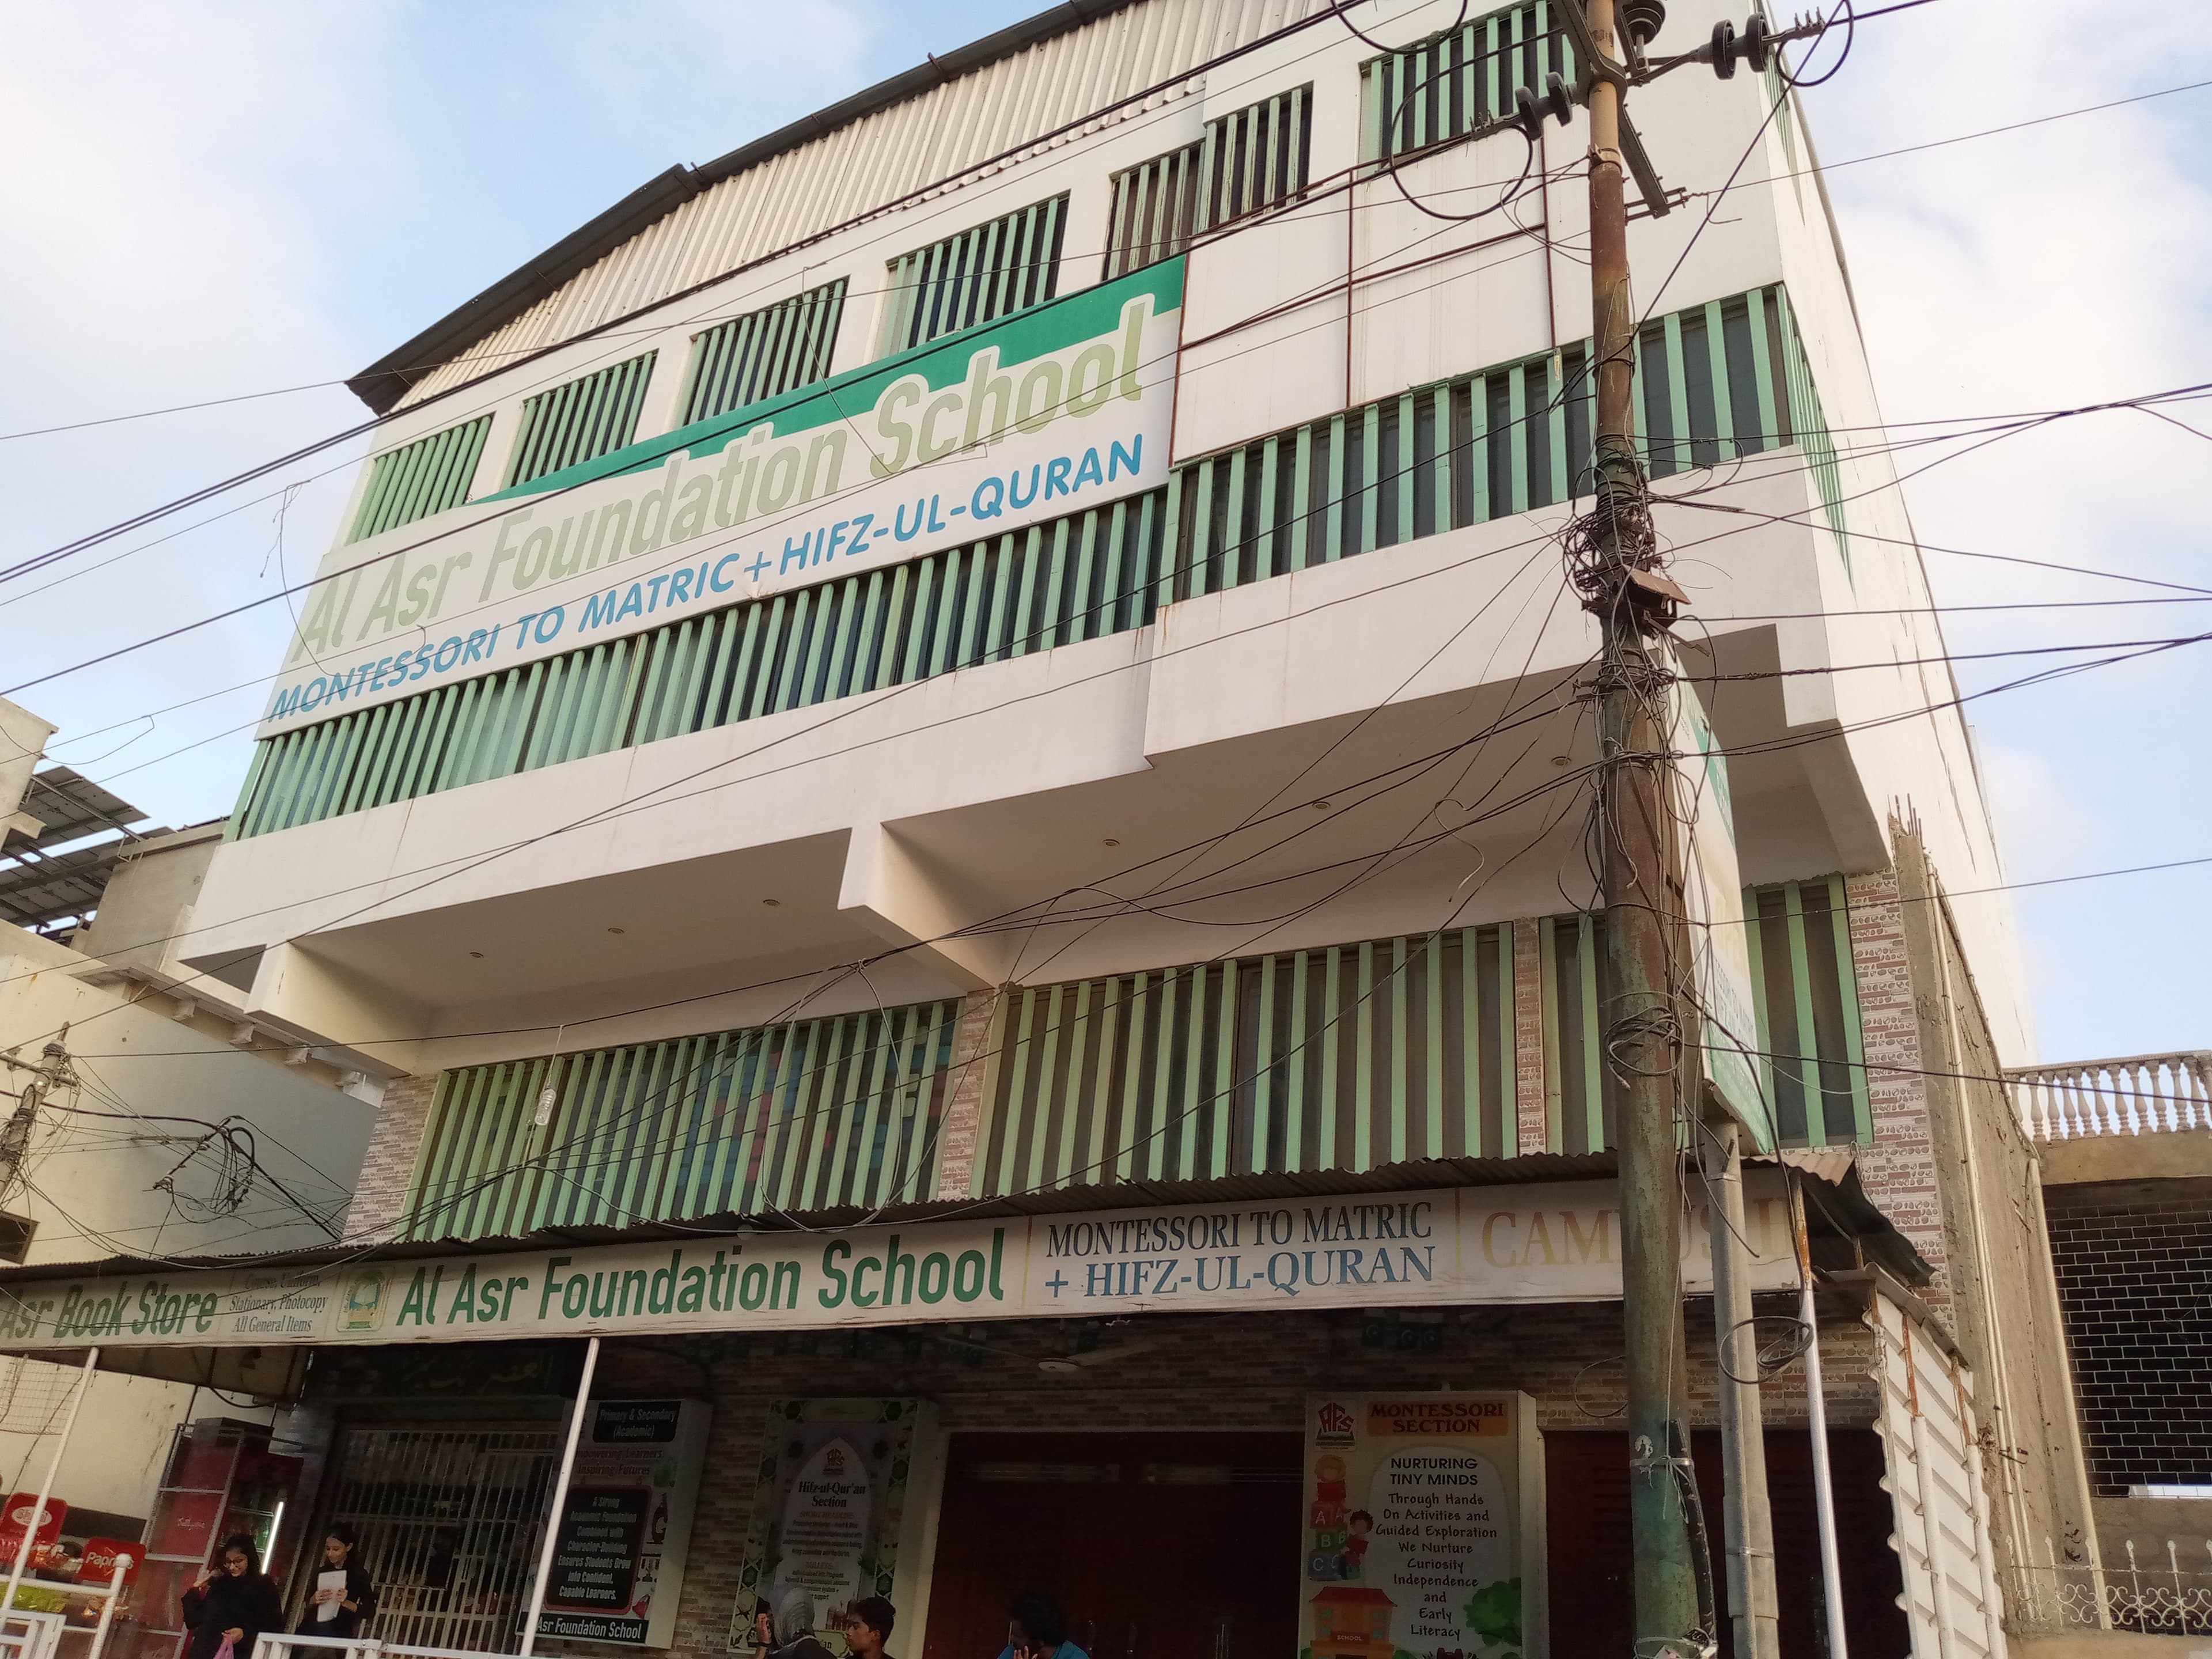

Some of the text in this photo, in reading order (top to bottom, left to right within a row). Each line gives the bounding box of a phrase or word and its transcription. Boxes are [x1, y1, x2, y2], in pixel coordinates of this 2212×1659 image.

[291, 303, 1145, 662] Al Asr Foundation School
[268, 634, 499, 723] MONTESSORI
[517, 607, 565, 649] TO
[578, 554, 740, 632] MATRIC
[780, 434, 1142, 575] HIFZ-UL-QURAN
[1047, 1202, 1431, 1257] MONTESSORI TO MATRIC
[396, 1265, 444, 1325] Al
[446, 1263, 528, 1323] Asr
[539, 1245, 801, 1320] Foundation
[818, 1227, 1005, 1308] School
[1084, 1245, 1435, 1297] HIFZ-UL-QURAN
[1, 1281, 218, 1339] Asr Book Store
[279, 1294, 328, 1313] Photocopy
[235, 1315, 312, 1332] All General Items
[599, 1408, 675, 1423] Primary & Secondary
[1370, 1403, 1503, 1417] MONTESSORI
[613, 1425, 654, 1440] (Academic)
[1393, 1419, 1480, 1433] SECTION
[576, 1448, 662, 1460] mpowering Learners
[578, 1464, 650, 1476] Inspiring Futures
[1391, 1458, 1478, 1469] NURTURING
[1391, 1474, 1478, 1485] TINY MINDS
[812, 1495, 847, 1507] Section
[1388, 1493, 1483, 1508] Through Hands
[1315, 1511, 1325, 1525] A
[1384, 1509, 1489, 1521] On Activities and
[1376, 1524, 1497, 1540] Guided Exploration
[1321, 1535, 1331, 1548] B
[1399, 1541, 1473, 1554] We Nurture
[558, 1555, 584, 1567] Ensures
[585, 1556, 613, 1569] Students
[1312, 1558, 1324, 1571] C
[1407, 1558, 1464, 1574] Curiosity
[1393, 1574, 1478, 1589] Independence
[558, 1586, 586, 1598] Capable
[1424, 1591, 1446, 1603] and
[1419, 1608, 1452, 1623] Early
[555, 1618, 607, 1637] Foundation
[608, 1622, 642, 1639] School
[1411, 1624, 1460, 1641] Literacy
